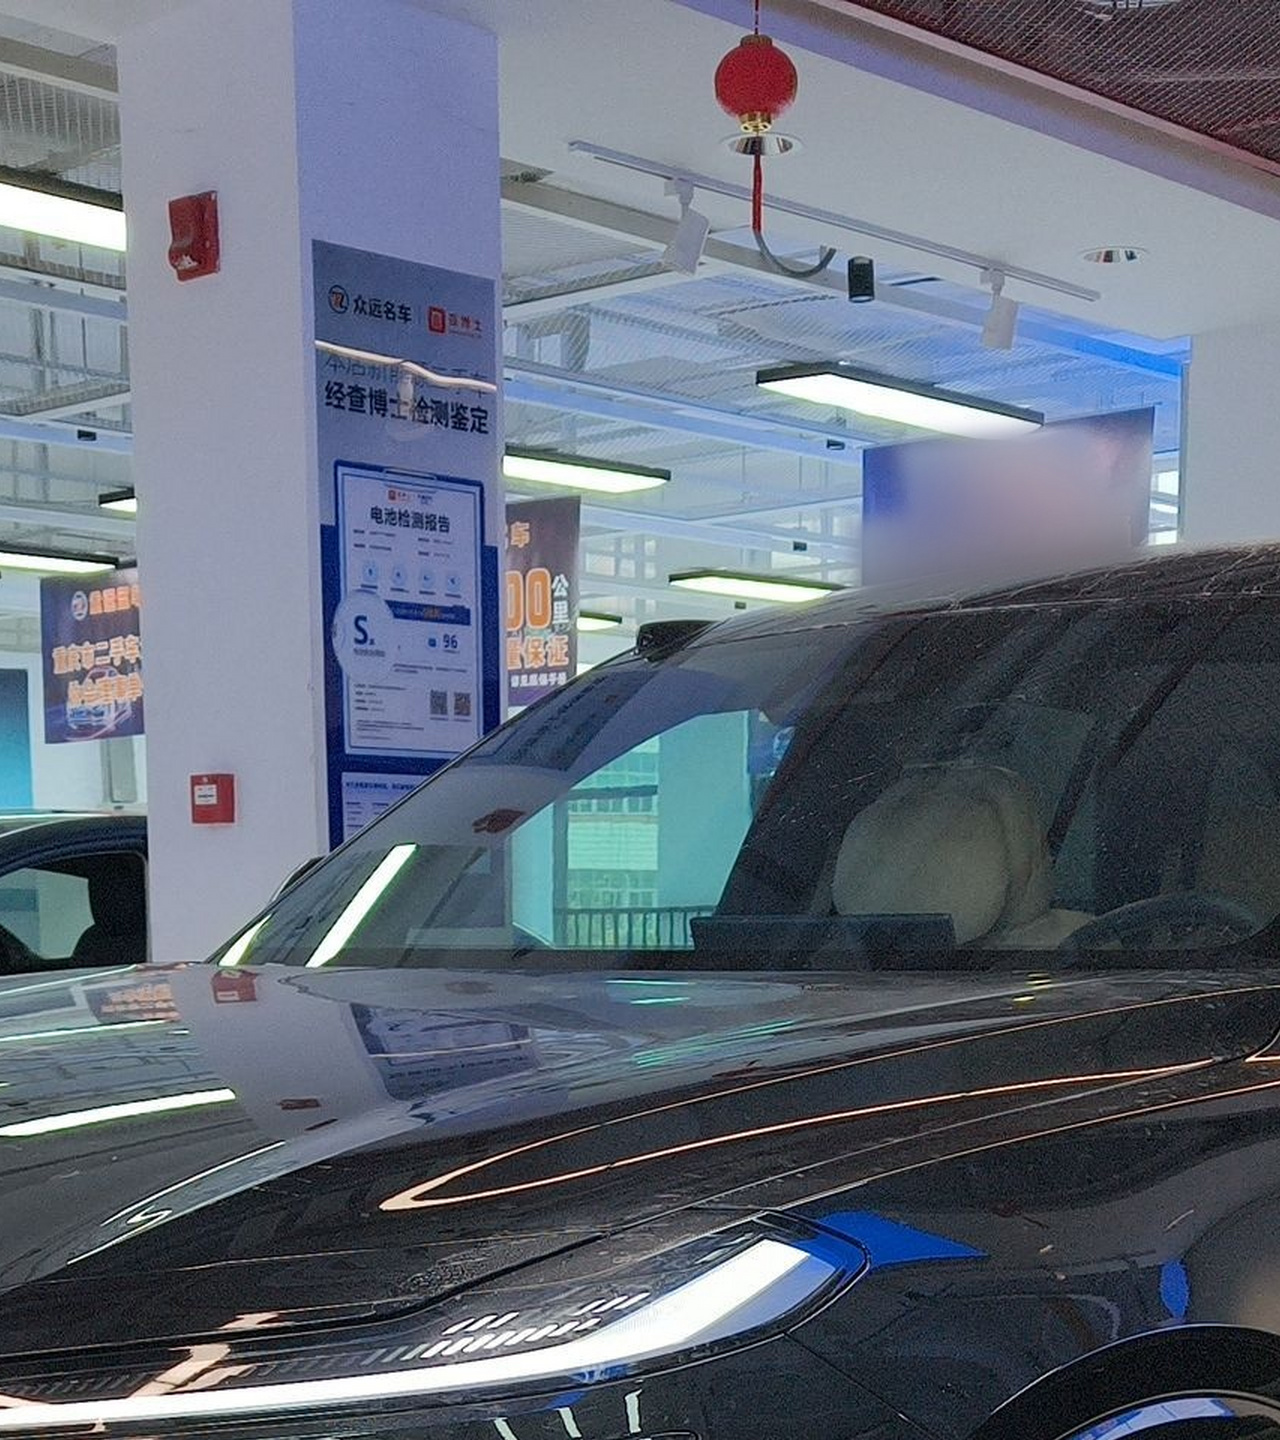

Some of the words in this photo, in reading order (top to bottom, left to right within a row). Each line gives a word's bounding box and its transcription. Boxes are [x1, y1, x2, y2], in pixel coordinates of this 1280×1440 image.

[353, 294, 412, 324] 众远名车
[325, 380, 489, 434] 经查博士检测鉴定
[370, 505, 451, 533] 电池检测报告
[551, 573, 569, 625] 公里
[443, 633, 459, 649] 96
